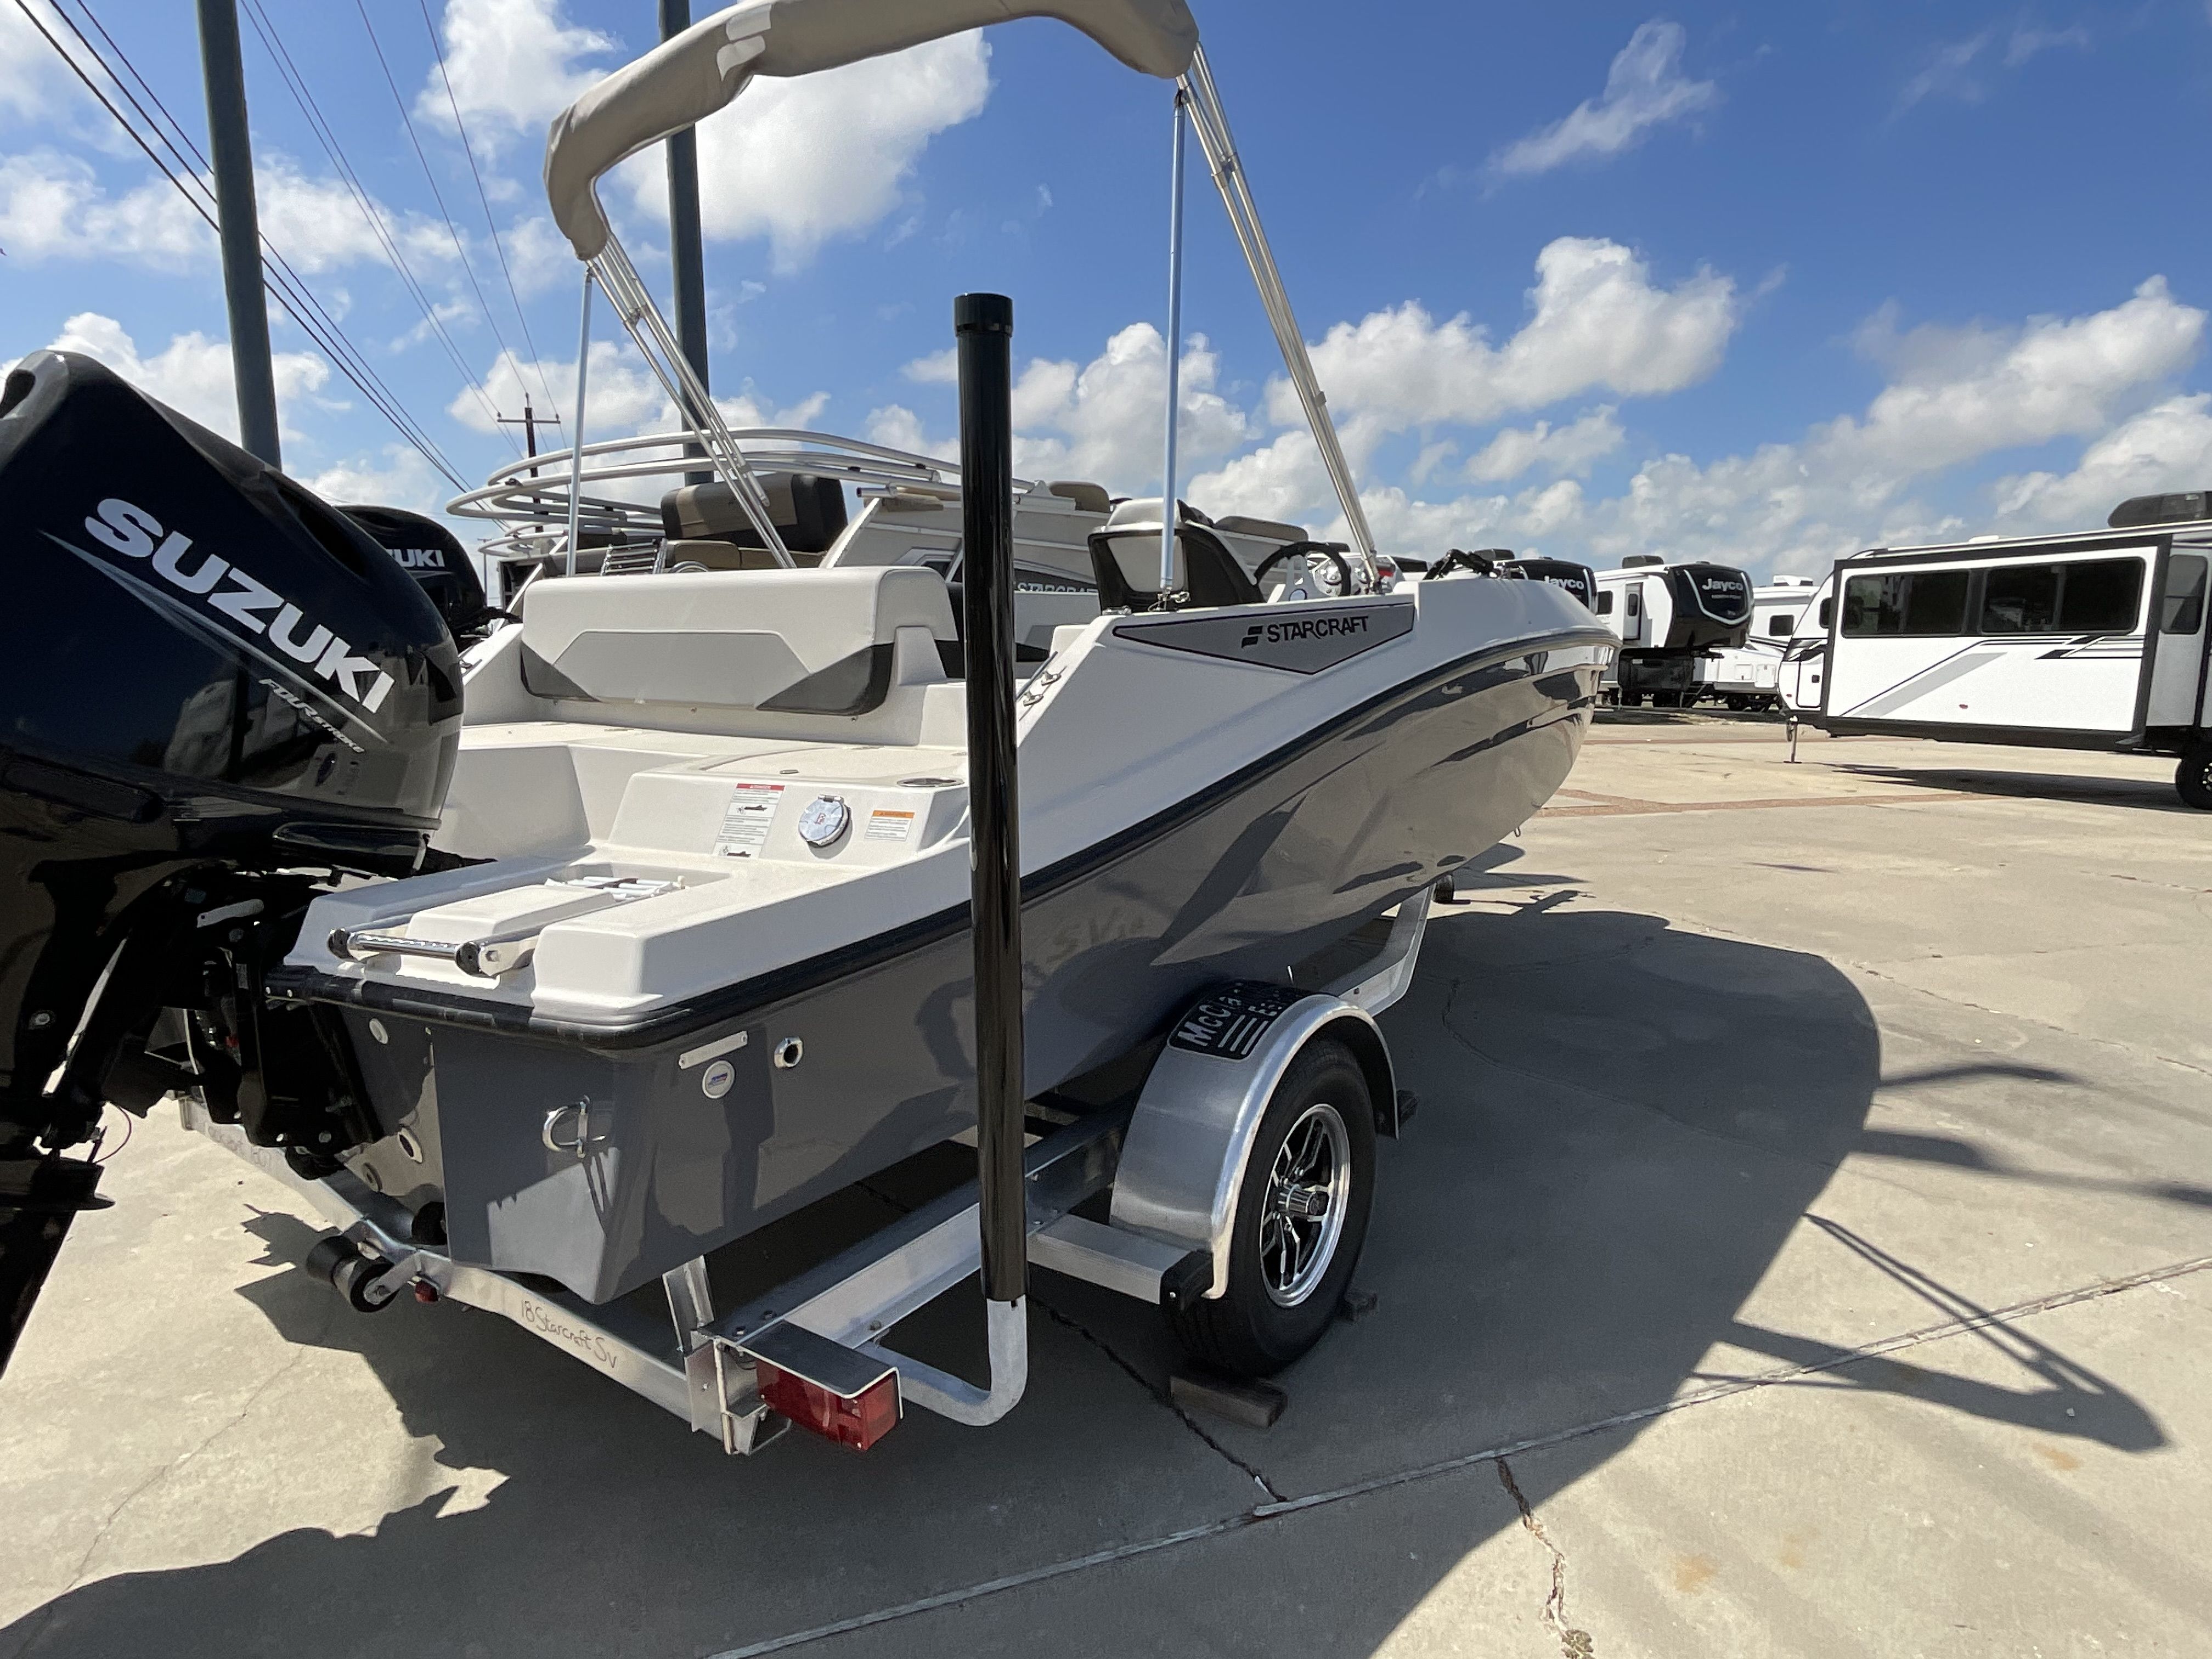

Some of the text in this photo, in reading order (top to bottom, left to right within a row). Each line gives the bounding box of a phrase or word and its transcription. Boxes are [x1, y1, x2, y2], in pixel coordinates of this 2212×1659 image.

[386, 549, 445, 567] UKI
[1702, 578, 1743, 592] Jayco
[85, 498, 394, 713] SUZUKI
[1267, 616, 1369, 643] STARCRAFT
[522, 1300, 534, 1322] 18
[535, 1307, 591, 1351] Starcraft
